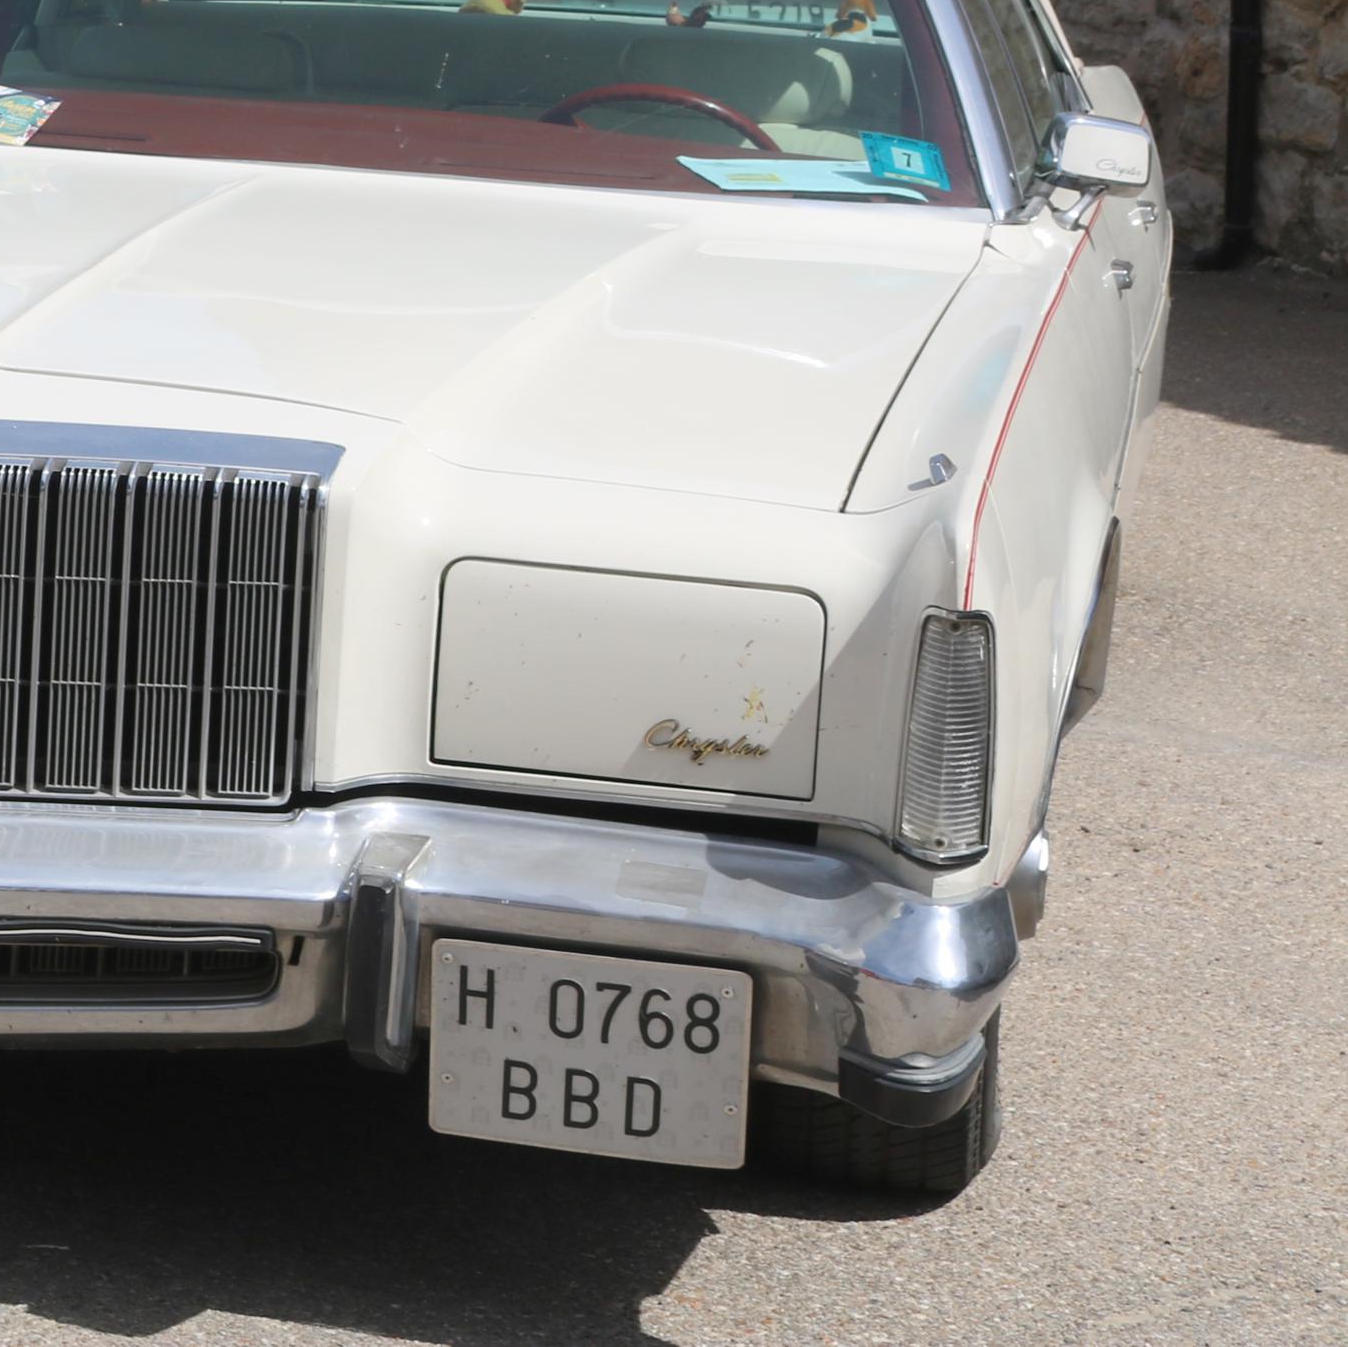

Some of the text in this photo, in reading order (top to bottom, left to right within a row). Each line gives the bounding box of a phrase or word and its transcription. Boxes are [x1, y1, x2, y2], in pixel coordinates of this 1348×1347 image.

[901, 152, 911, 168] 7
[643, 718, 770, 762] Chrysler
[457, 964, 723, 1054] H 0768
